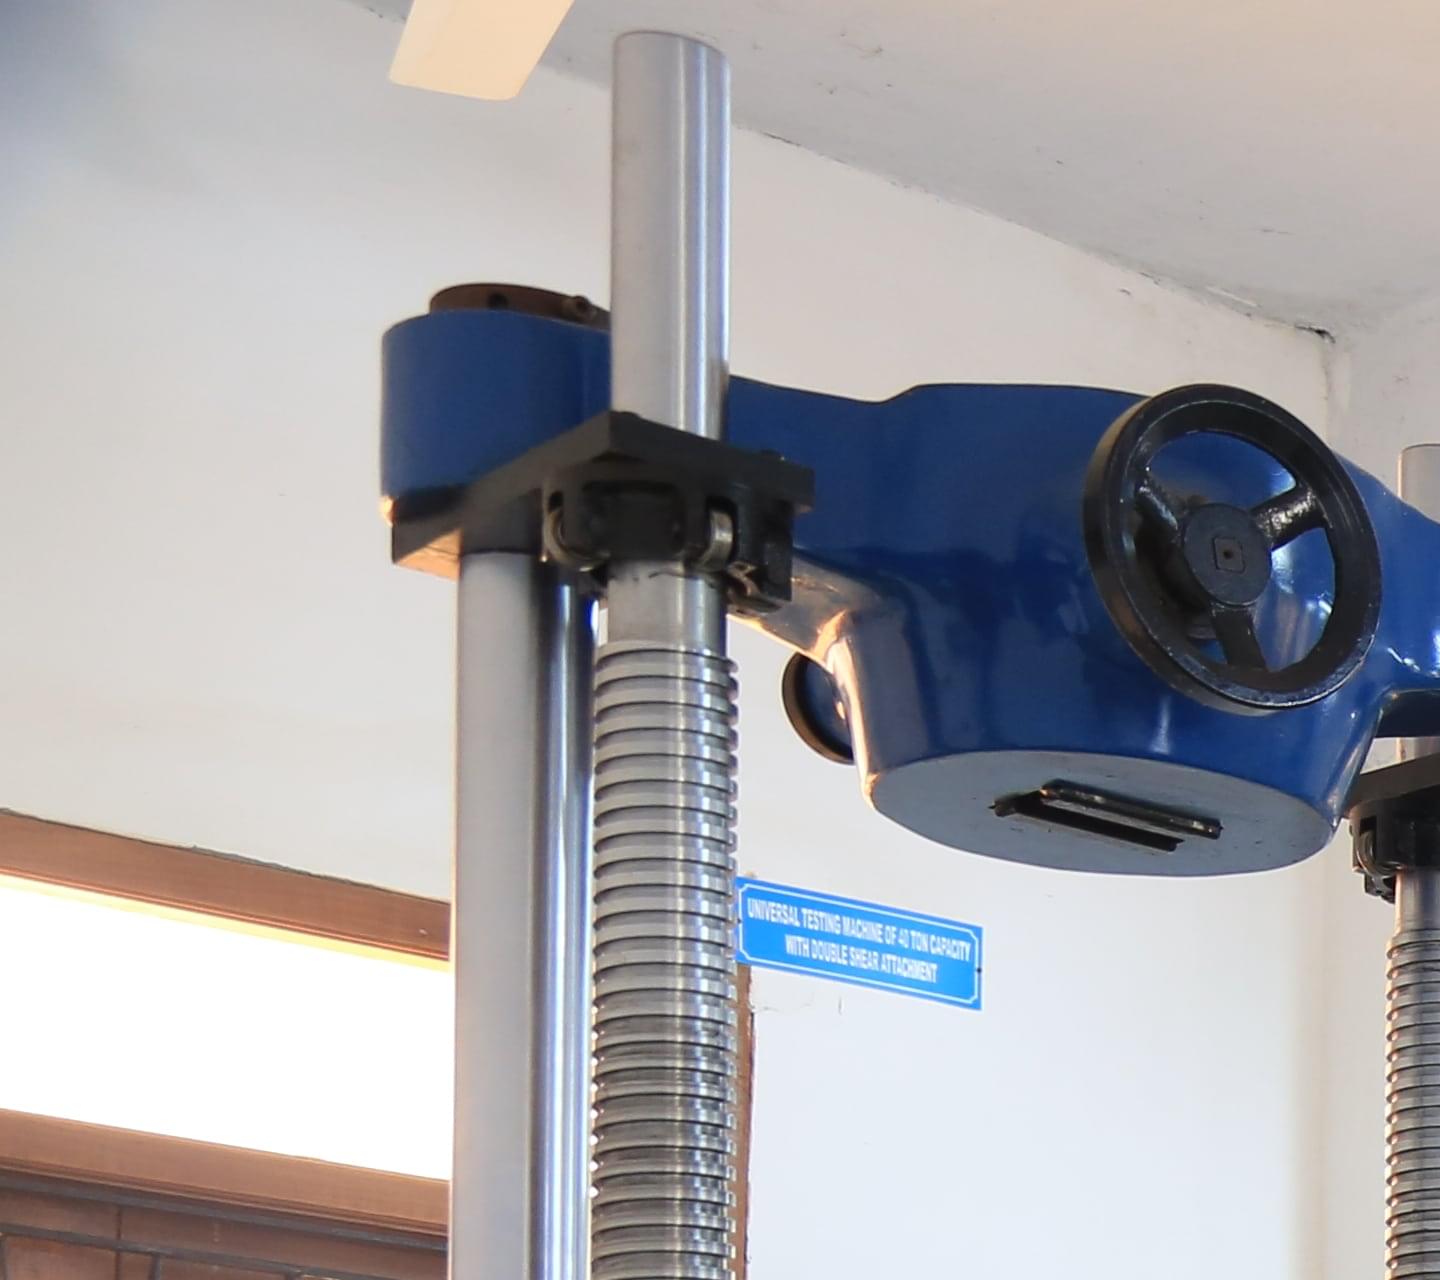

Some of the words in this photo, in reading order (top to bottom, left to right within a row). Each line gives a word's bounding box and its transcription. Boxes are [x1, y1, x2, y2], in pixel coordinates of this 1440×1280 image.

[748, 897, 800, 928] UNIVERSAL
[801, 907, 841, 935] TESTING
[842, 916, 883, 943] MACHINE
[885, 925, 896, 945] OF
[910, 930, 928, 953] TON
[929, 934, 971, 962] CAPACITY
[785, 934, 810, 958] WITH
[811, 939, 848, 966] DOUBLE
[849, 947, 879, 972] SHEAR
[880, 954, 938, 983] ATTACHMENT
